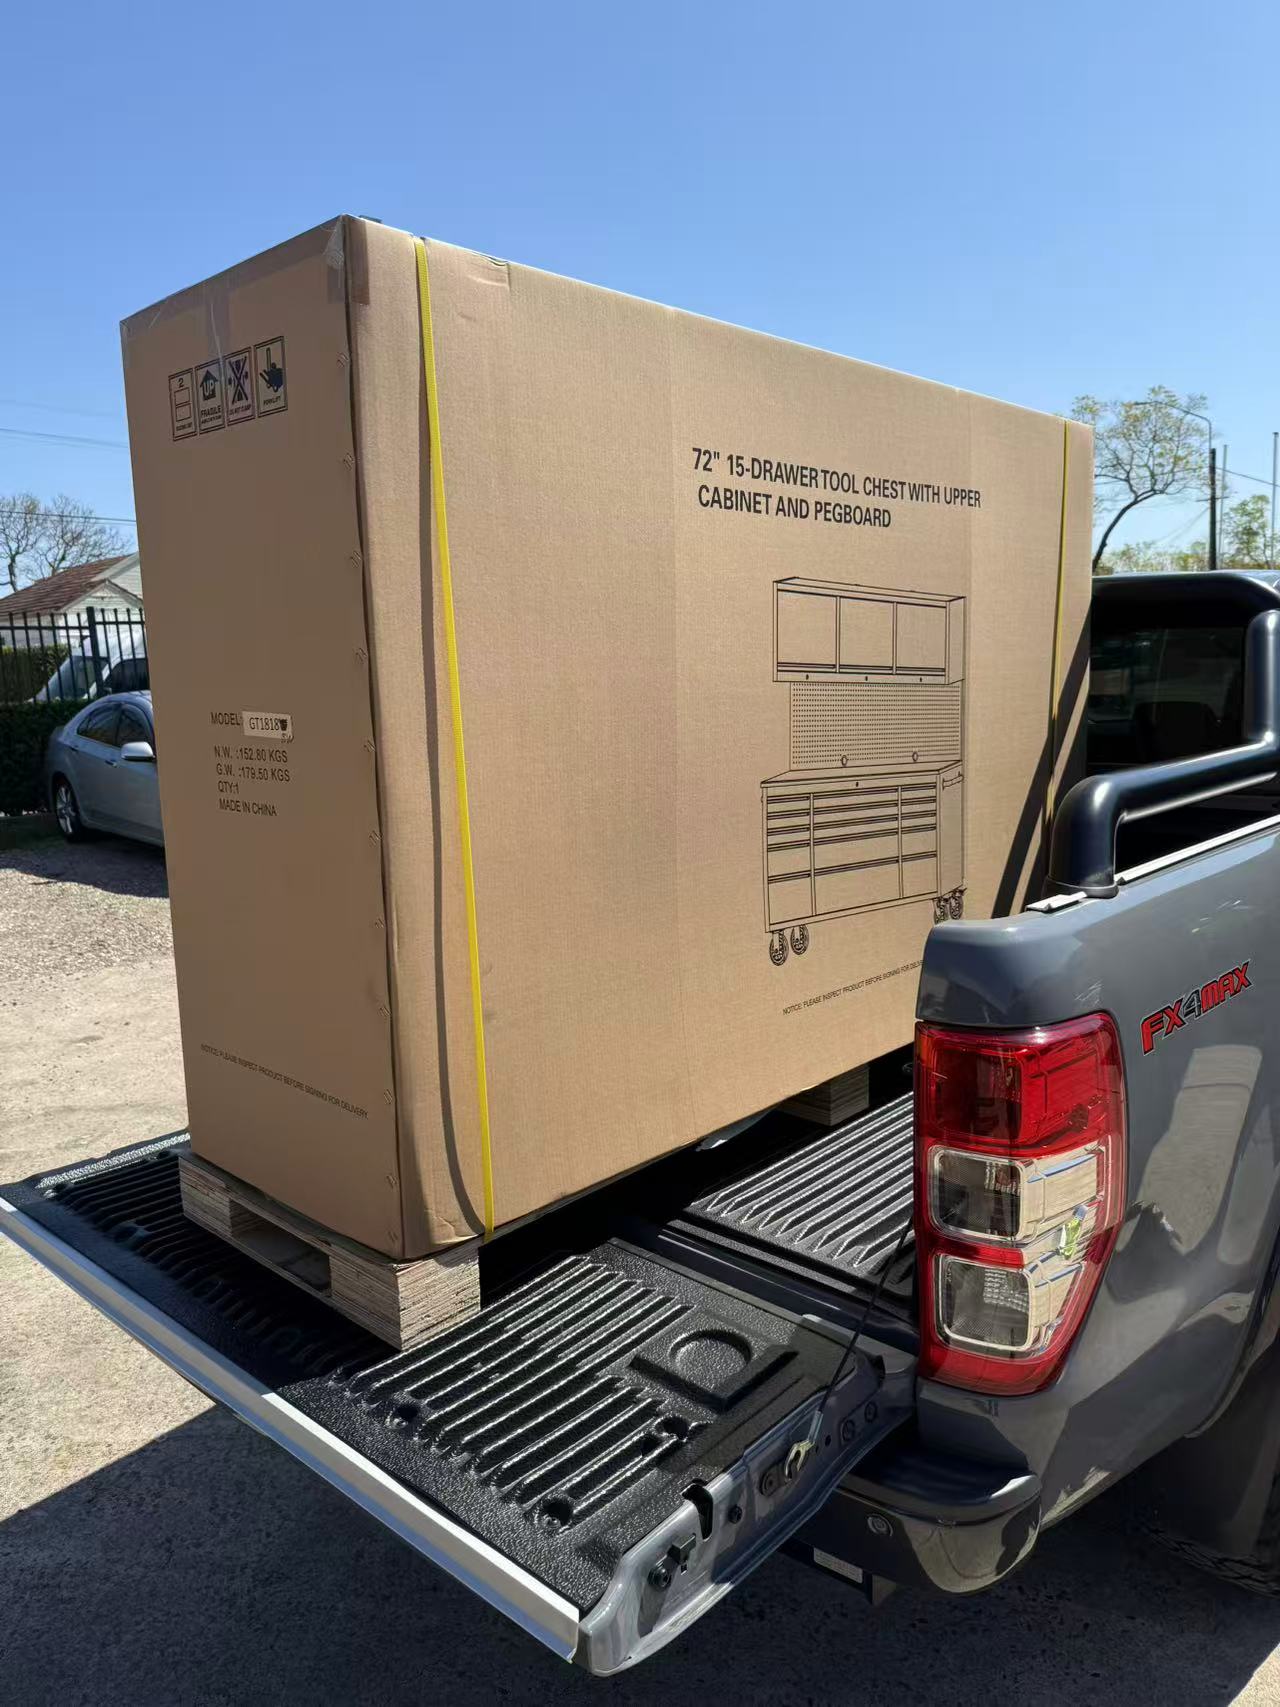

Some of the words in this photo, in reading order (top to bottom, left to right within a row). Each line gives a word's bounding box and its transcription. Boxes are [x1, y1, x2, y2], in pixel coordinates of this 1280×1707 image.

[178, 378, 184, 387] 2
[203, 380, 214, 396] UP
[201, 405, 222, 418] FRAGILE
[692, 447, 720, 472] 72"
[727, 454, 819, 489] 15-DRAWER
[821, 469, 860, 495] TOOL
[863, 476, 906, 500] CHEST
[908, 482, 940, 504] WITH
[944, 486, 981, 508] UPPER
[698, 484, 772, 515] CABINET
[775, 496, 810, 519] AND
[814, 501, 892, 528] PEGBOARD
[269, 749, 288, 763] KGS
[271, 768, 291, 782] KGS
[219, 798, 241, 813] MADE
[242, 801, 250, 813] IN
[251, 802, 278, 816] CHINA
[803, 996, 822, 1008] PLEASE
[822, 988, 842, 1001] INSPECT
[842, 980, 865, 993] PRODUCT
[865, 974, 883, 985] BEFORE
[883, 968, 901, 980] SIGNING
[901, 964, 909, 972] FOR
[238, 1057, 258, 1071] INSPECT
[258, 1065, 283, 1081] PRODUCT
[283, 1075, 304, 1091] BEFORE
[304, 1084, 328, 1101] SIGNING
[328, 1095, 340, 1107] FOR
